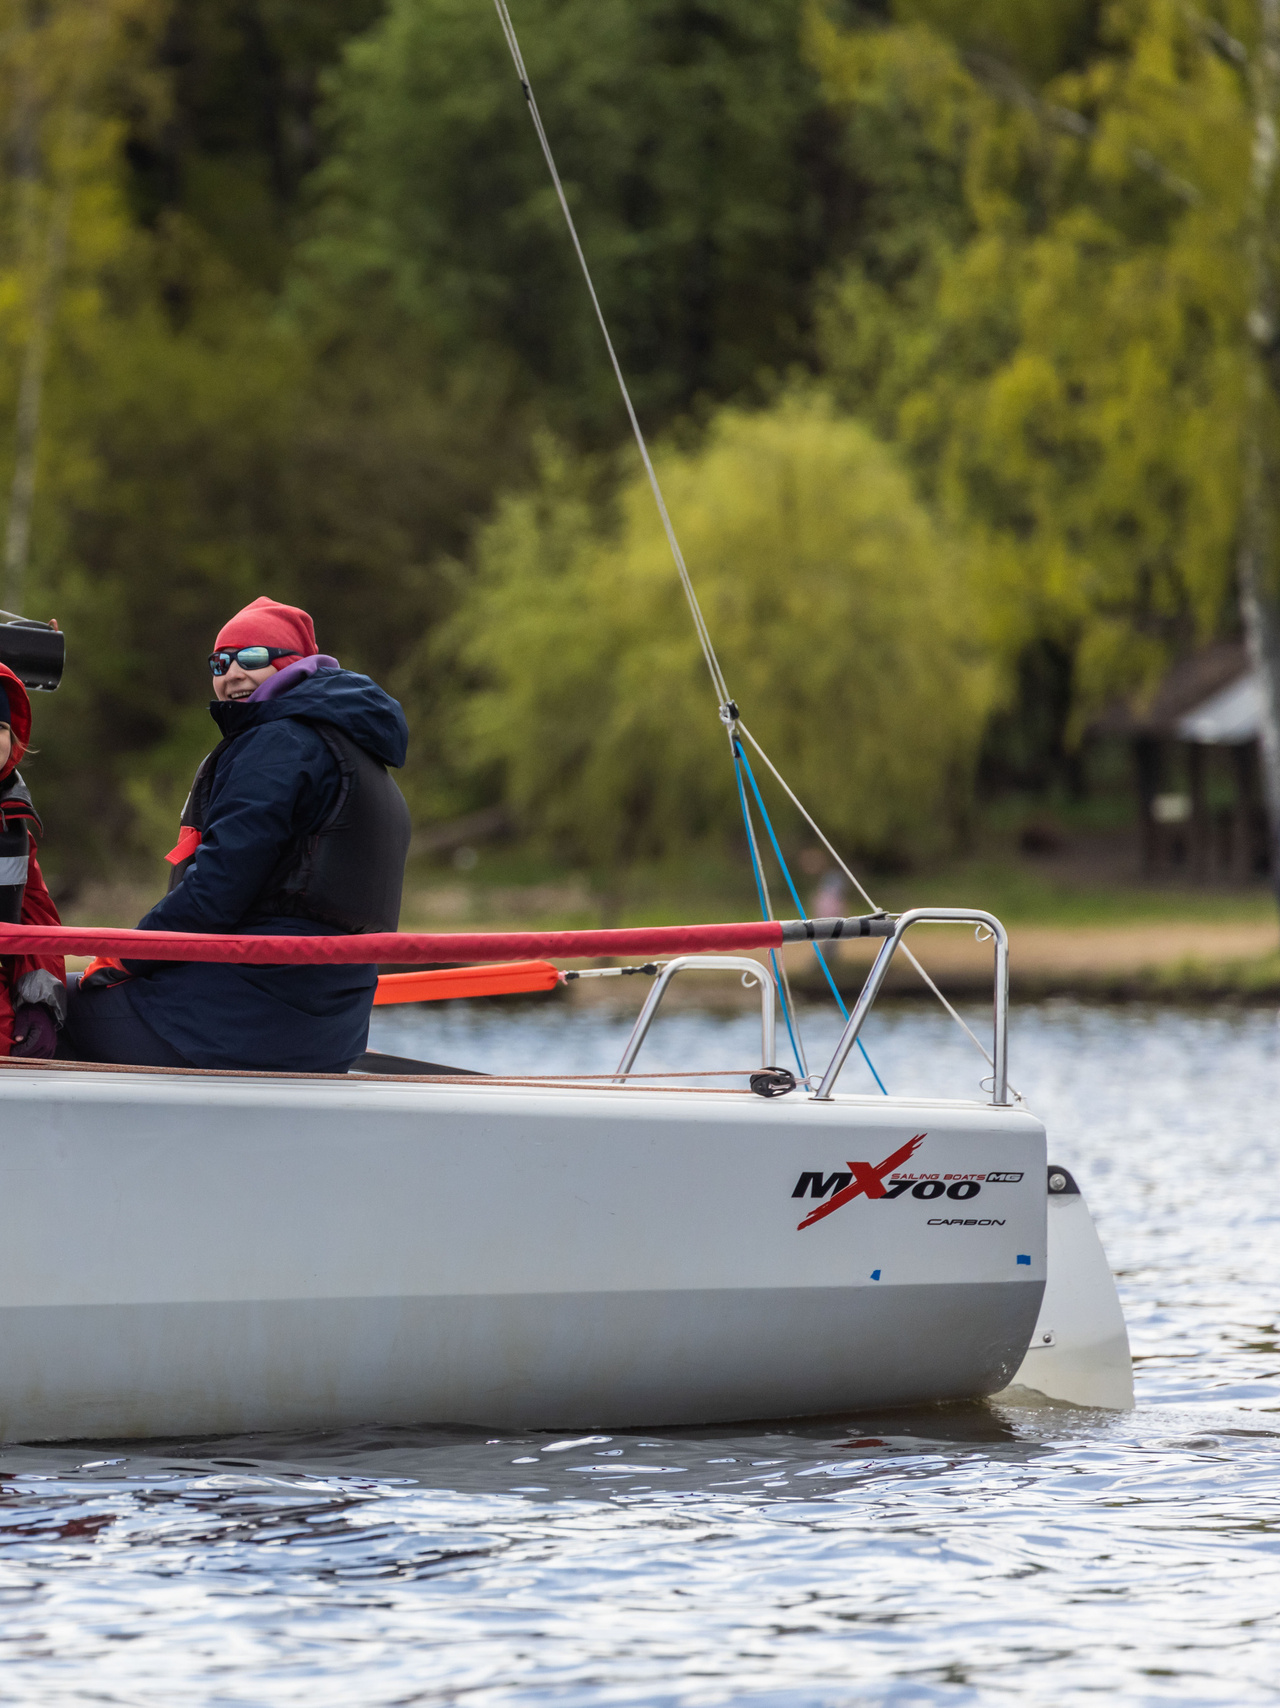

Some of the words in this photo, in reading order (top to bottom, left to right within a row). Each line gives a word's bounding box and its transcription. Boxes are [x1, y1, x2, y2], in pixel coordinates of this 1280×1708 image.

[943, 1173, 987, 1181] BOATS
[987, 1172, 1023, 1181] MG
[927, 1218, 1006, 1226] CARBON
